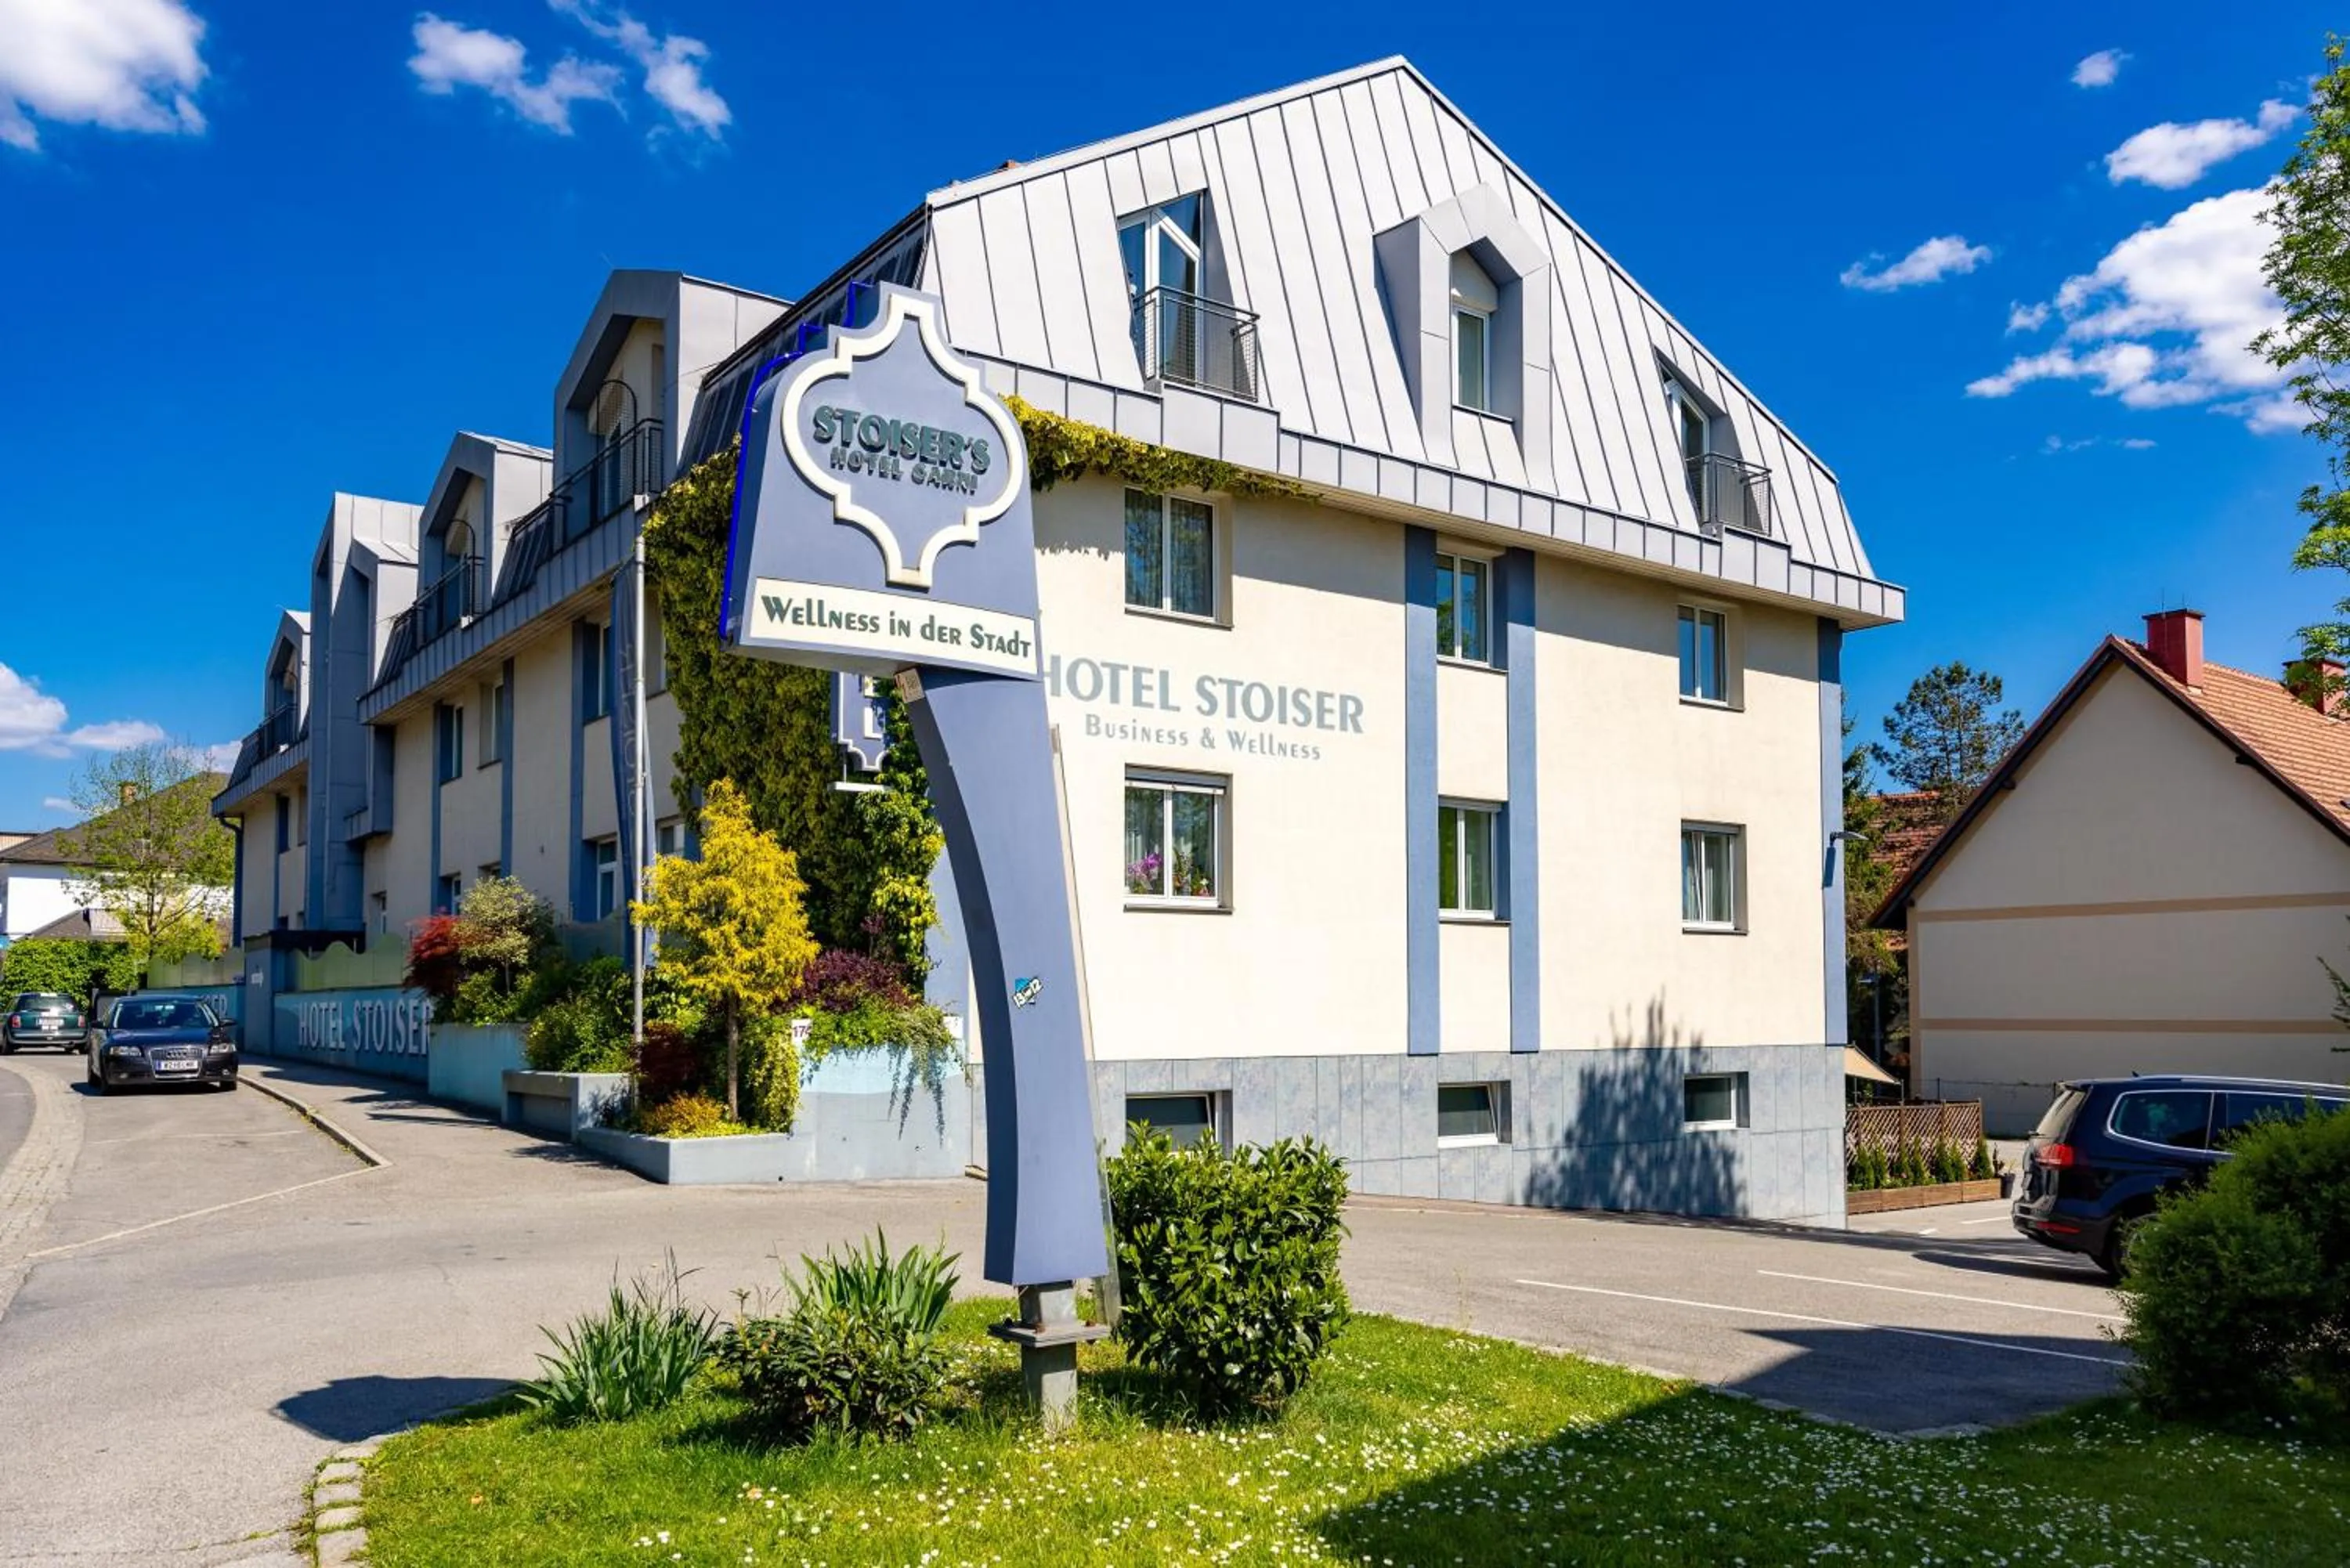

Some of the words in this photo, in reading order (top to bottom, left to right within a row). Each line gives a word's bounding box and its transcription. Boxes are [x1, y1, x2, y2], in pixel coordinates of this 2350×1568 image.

[813, 405, 990, 475] STOISER'S
[830, 446, 902, 481] HOTEL
[911, 463, 978, 496] GARNI
[1043, 654, 1181, 712] HOTEL
[1195, 674, 1365, 734] STOISER
[1200, 727, 1216, 750] &
[298, 1001, 345, 1050] HOTEL
